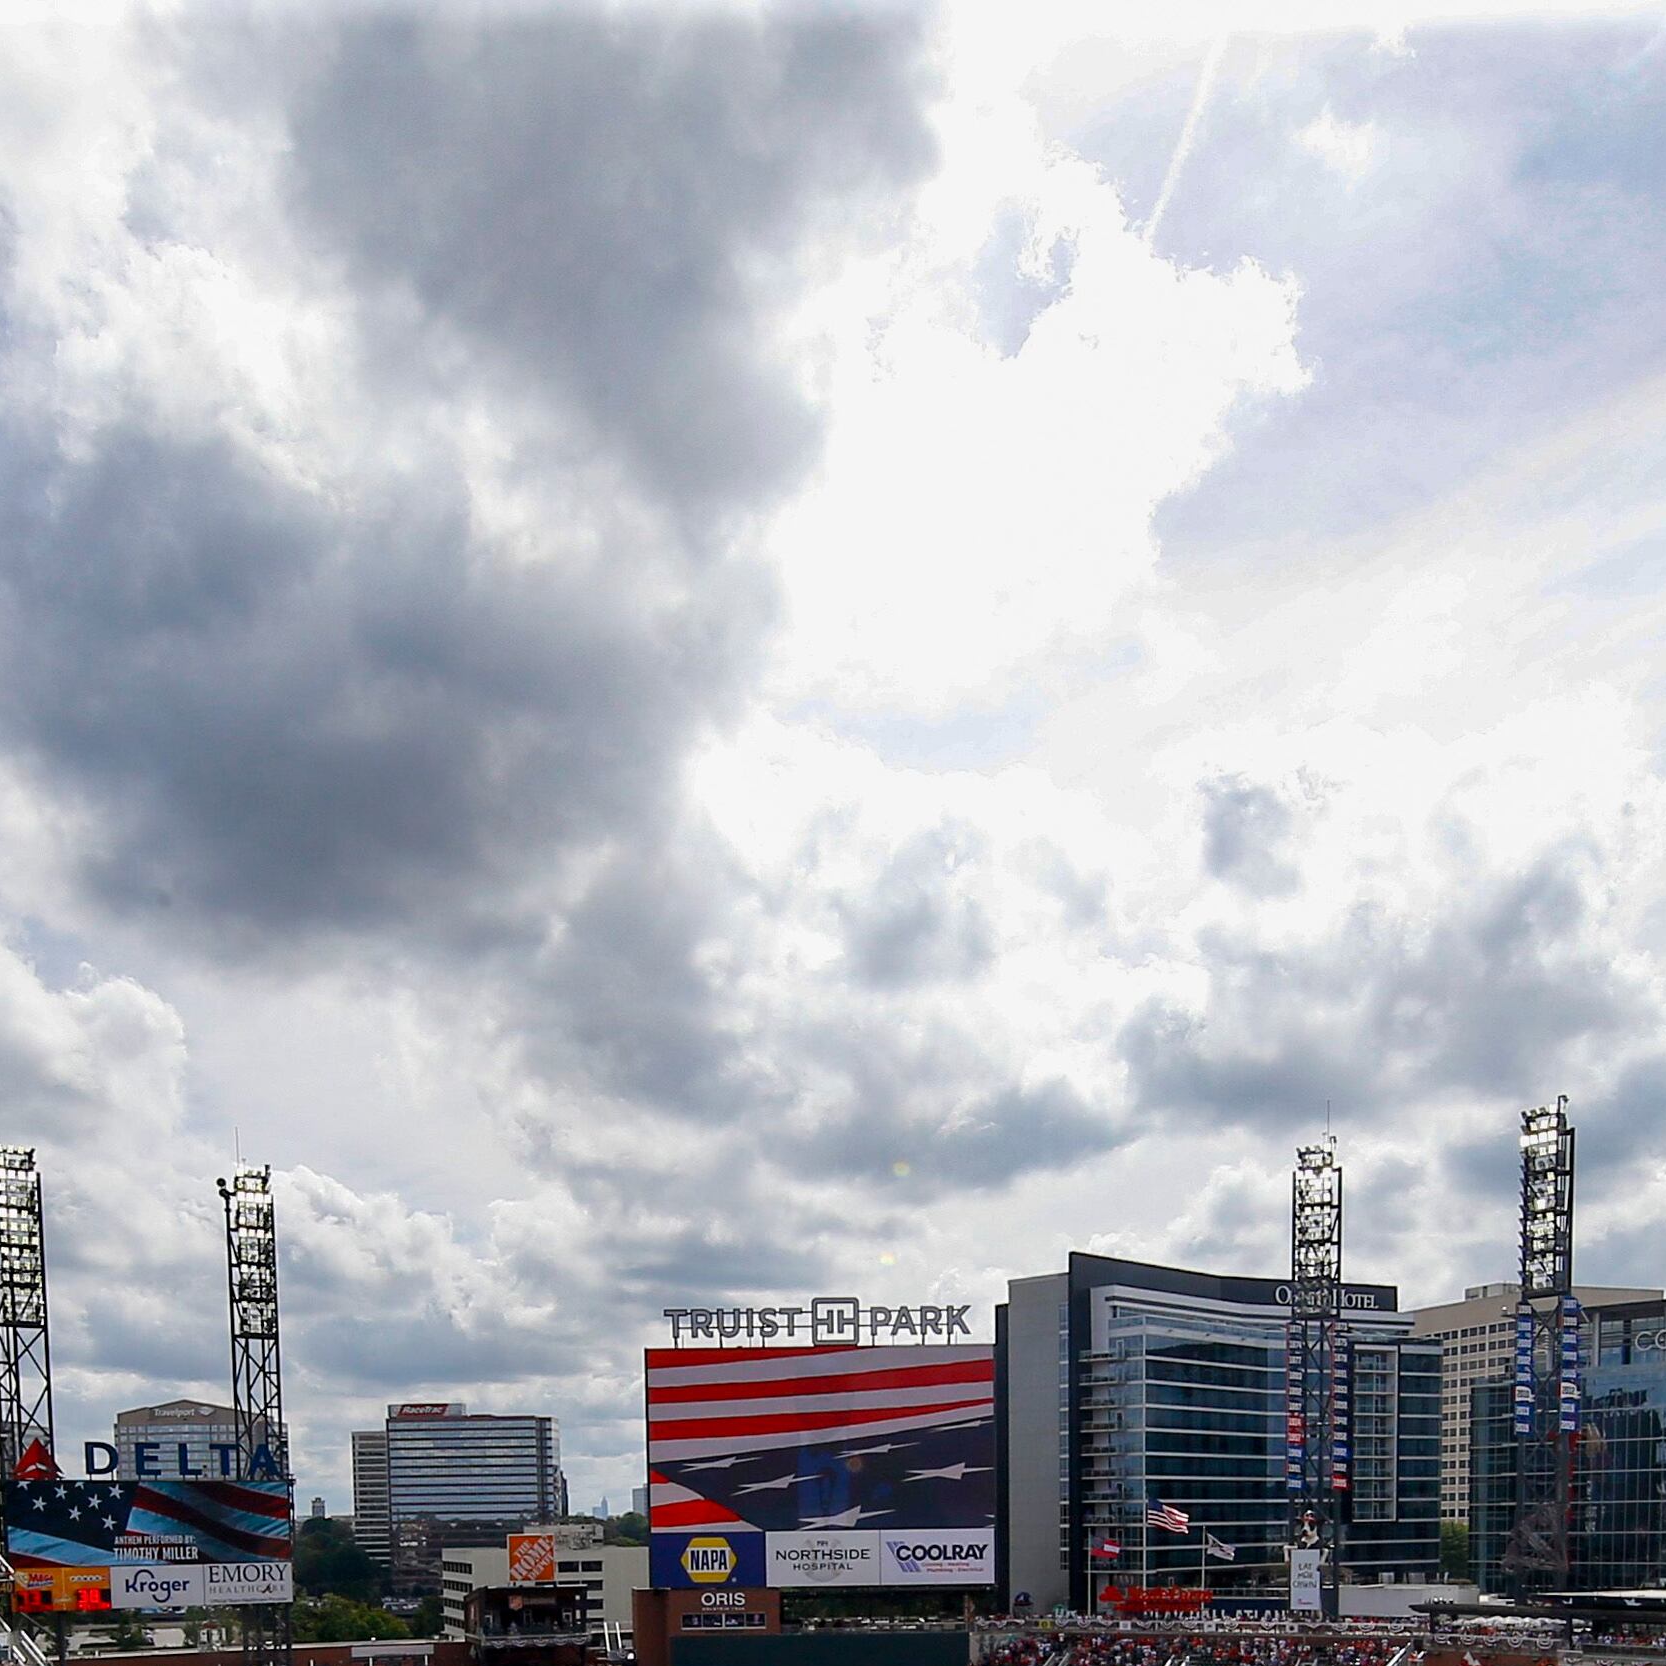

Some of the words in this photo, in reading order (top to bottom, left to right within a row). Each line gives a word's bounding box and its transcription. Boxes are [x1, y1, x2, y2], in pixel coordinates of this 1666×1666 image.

[664, 1307, 806, 1338] TRUIST
[870, 1305, 972, 1336] PARK
[154, 1407, 195, 1418] Travelport
[403, 1405, 444, 1415] RaceTrac
[84, 1441, 281, 1476] DELTA
[114, 1535, 142, 1545] ANTHEM
[143, 1535, 179, 1545] PERFORMED
[113, 1547, 159, 1561] TIMOTHY
[162, 1546, 199, 1560] MILLER
[511, 1535, 554, 1580] HOME
[690, 1550, 729, 1571] NAPA
[775, 1548, 871, 1561] NORTHSIDE
[895, 1544, 990, 1562] COOLRAY
[208, 1564, 289, 1584] EMORY
[792, 1562, 854, 1571] HOSPITAL
[125, 1569, 191, 1604] Kroger
[209, 1584, 286, 1595] HEALTHCARE
[701, 1592, 746, 1606] ORIS
